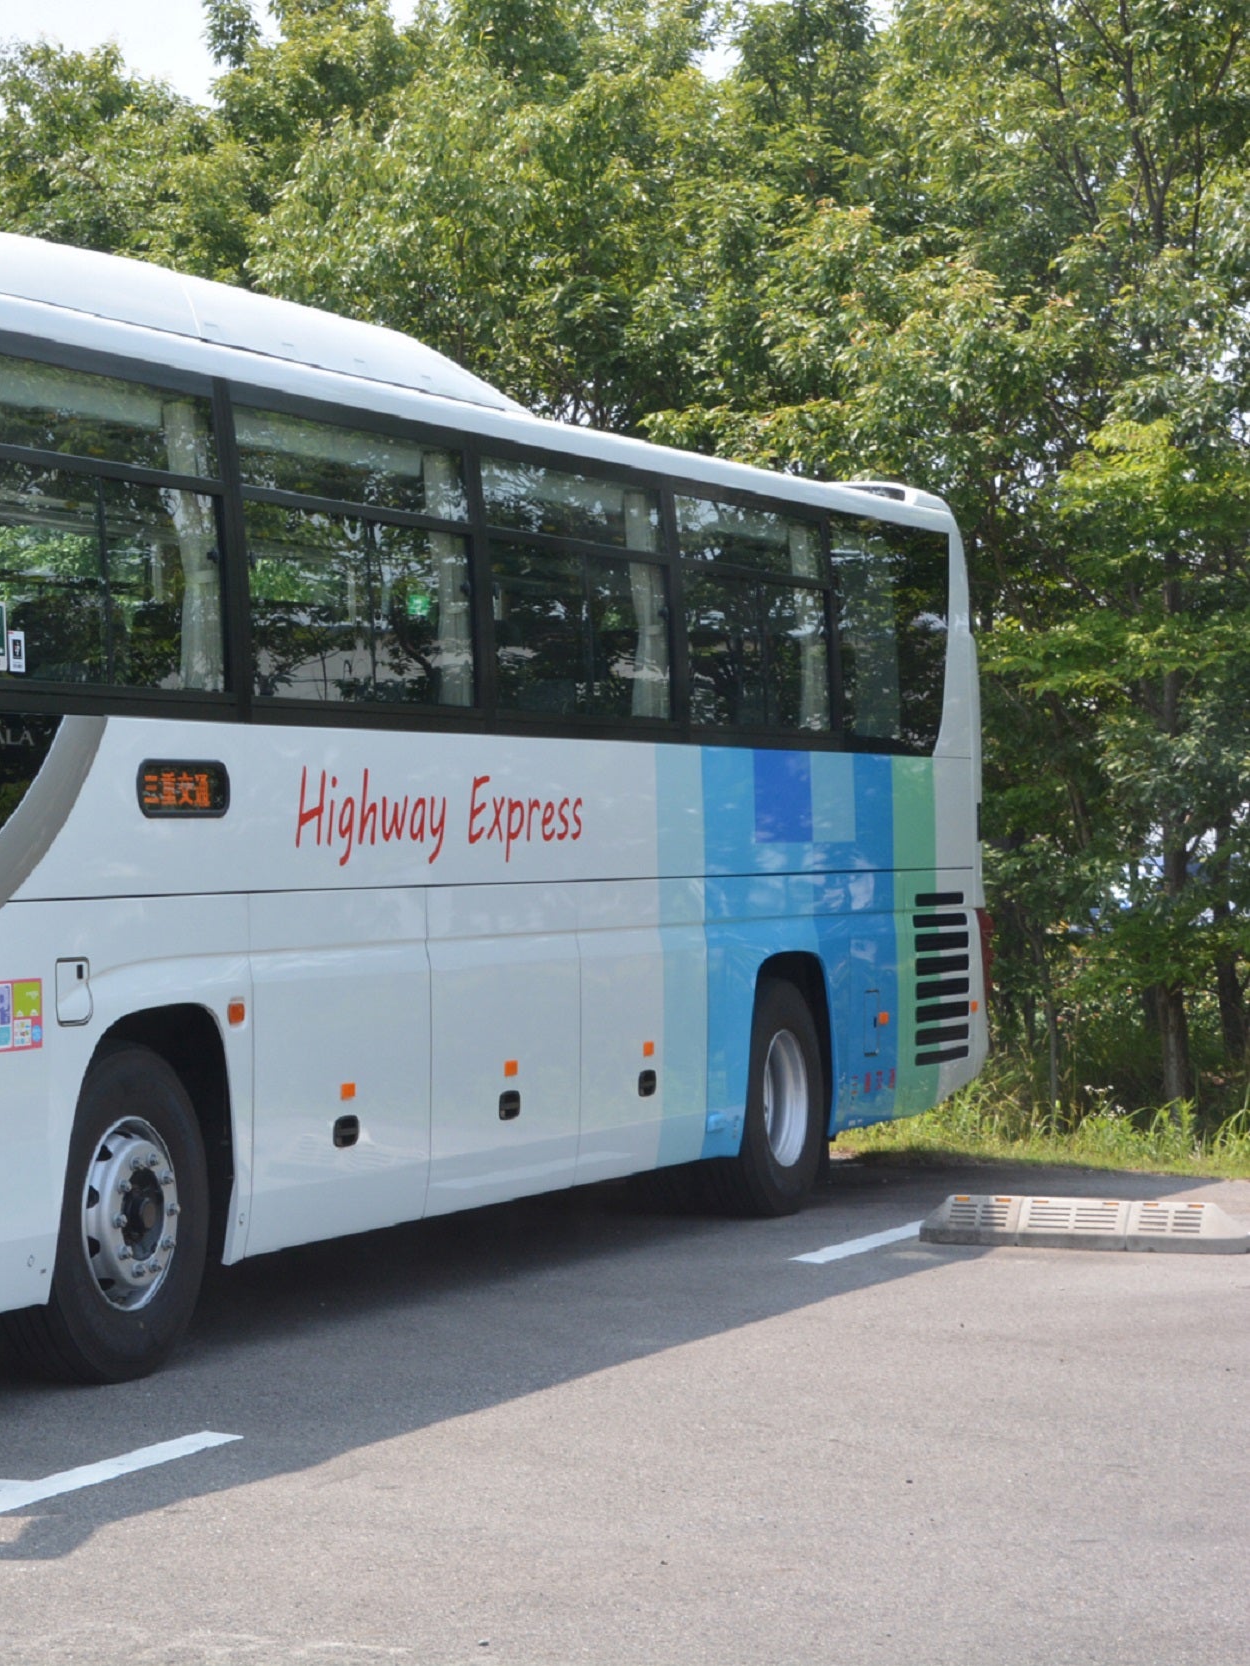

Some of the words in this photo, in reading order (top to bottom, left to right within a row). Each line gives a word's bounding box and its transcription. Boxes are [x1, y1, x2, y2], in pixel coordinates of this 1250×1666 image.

[143, 772, 211, 808] 三重交通
[295, 766, 447, 866] Highway
[468, 776, 583, 862] Express
